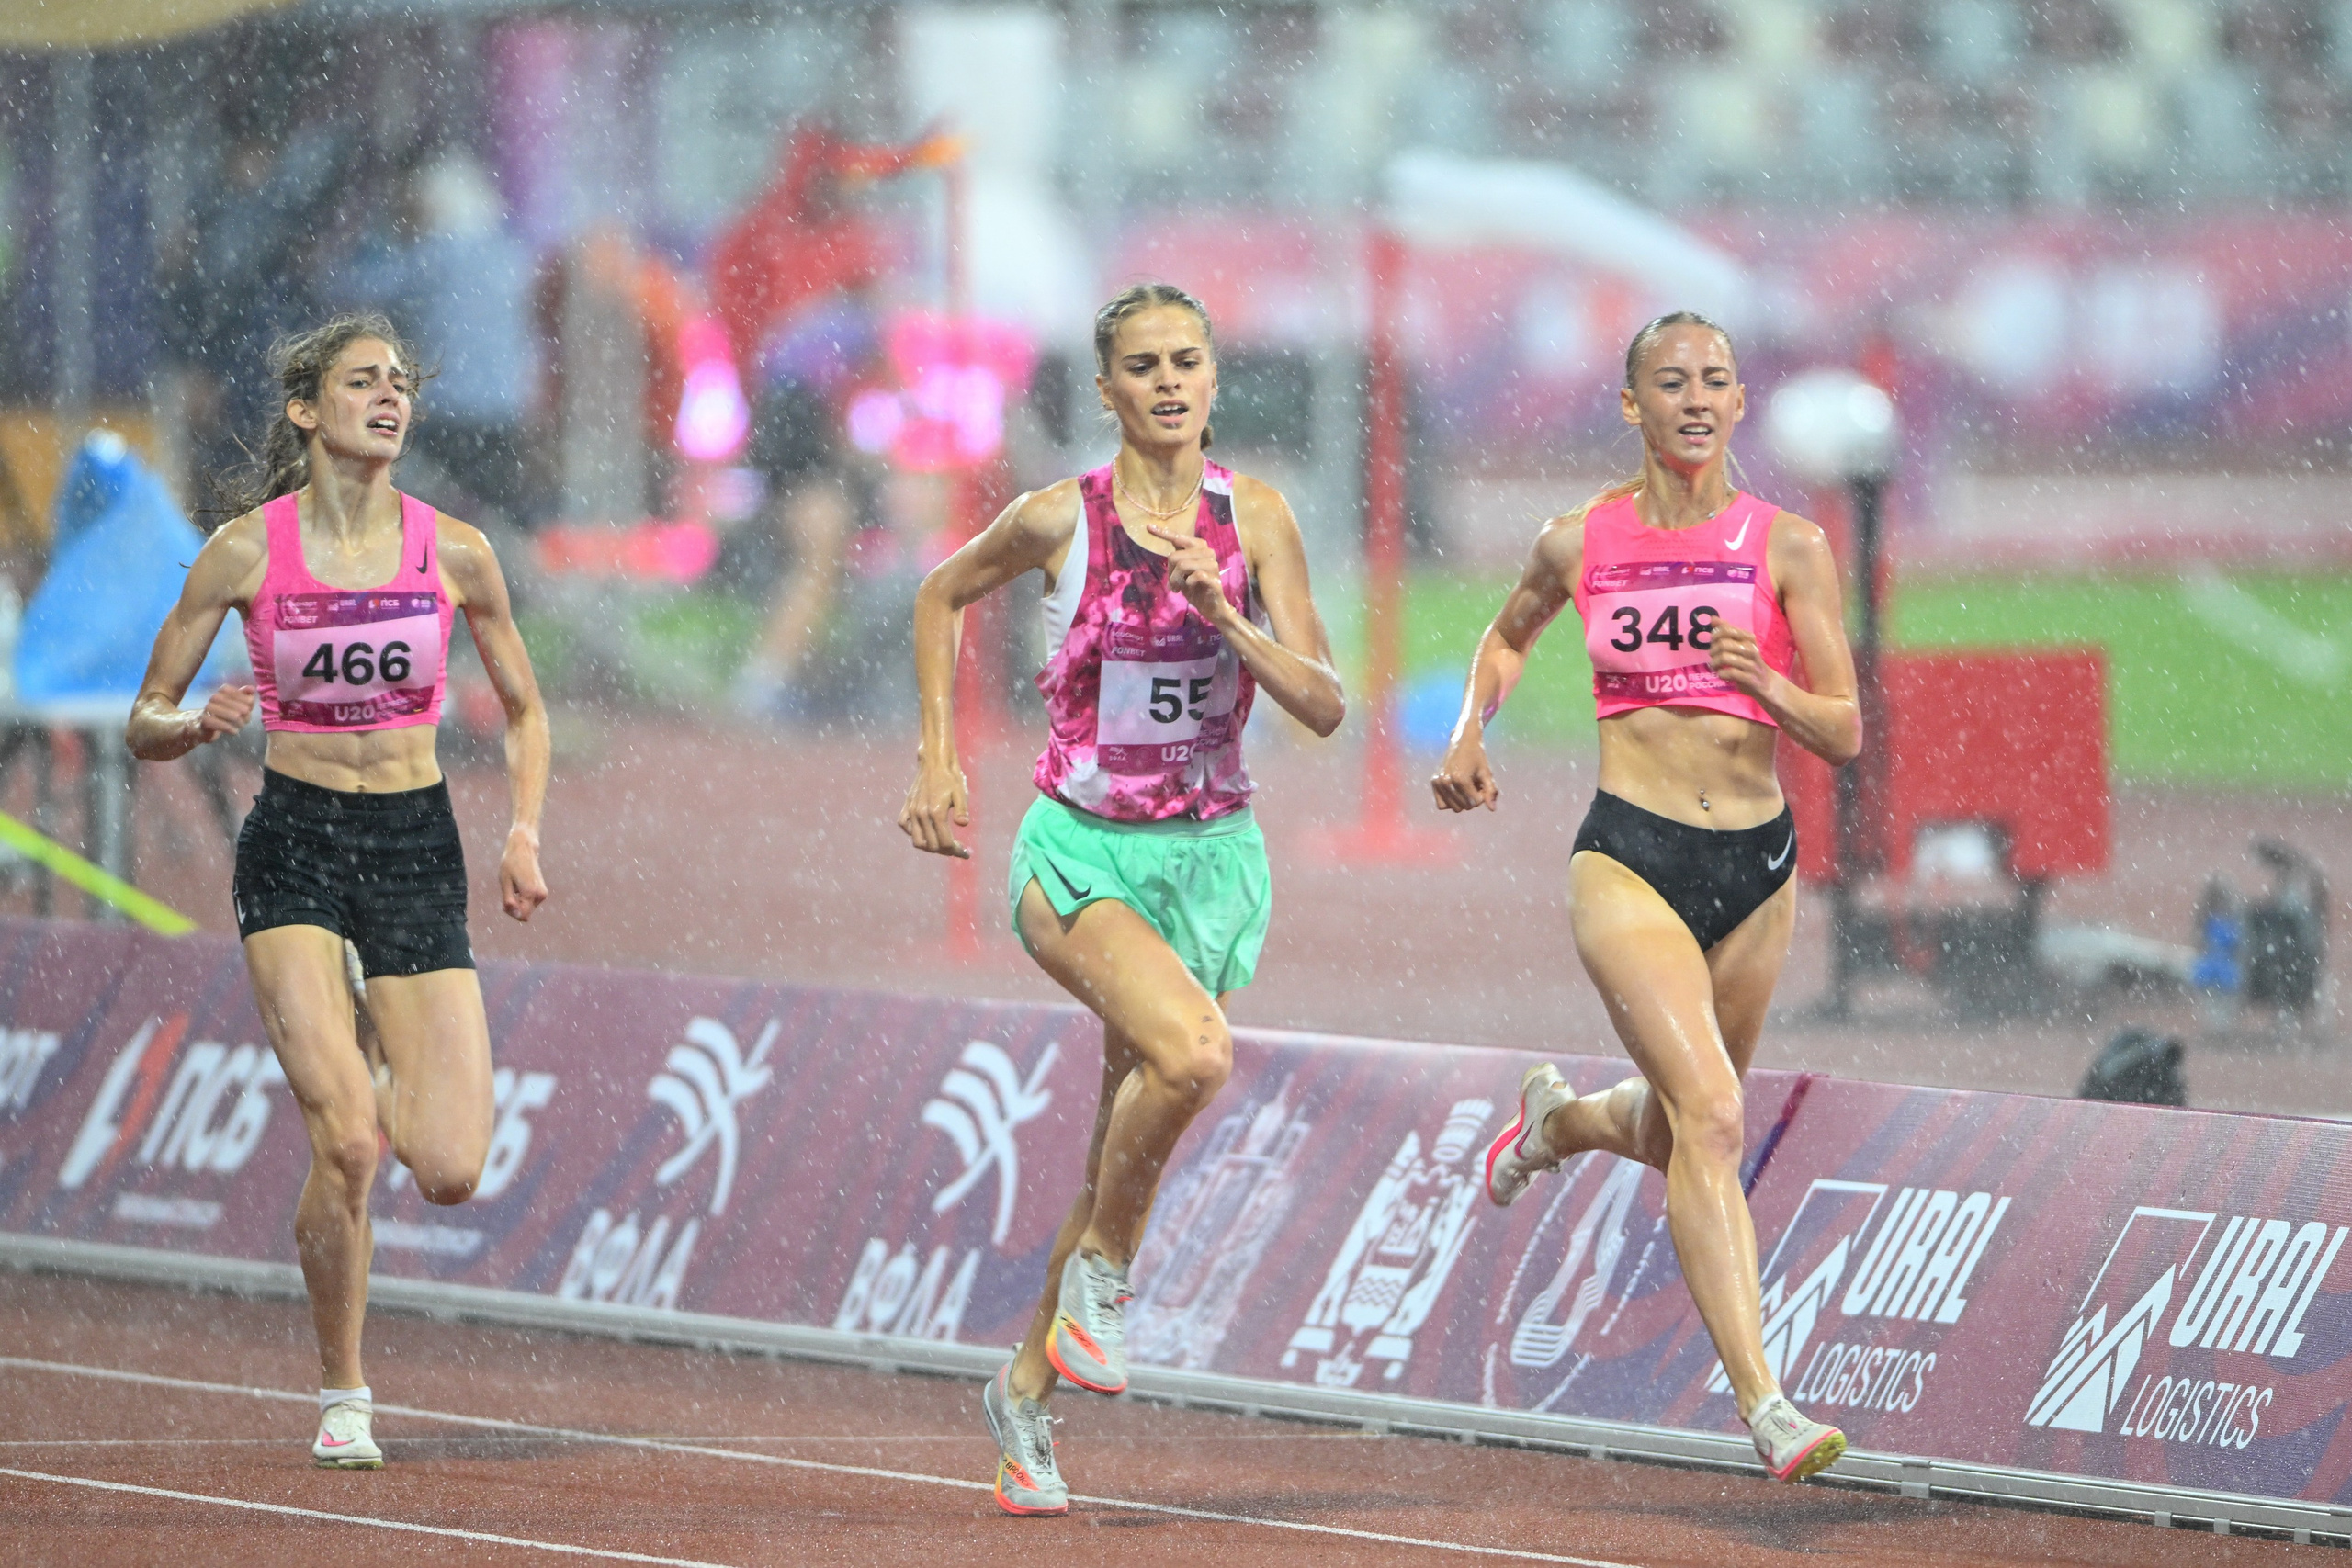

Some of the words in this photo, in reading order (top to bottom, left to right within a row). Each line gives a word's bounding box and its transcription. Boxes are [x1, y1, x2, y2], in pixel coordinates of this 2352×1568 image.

[1111, 646, 1146, 657] FONBET
[1611, 605, 1720, 652] 348
[302, 640, 412, 686] 466
[1645, 673, 1687, 693] U20
[334, 705, 376, 721] U20
[1149, 677, 1213, 724] 55
[1840, 1187, 2012, 1325] URAL
[2168, 1215, 2350, 1359] URAL
[1792, 1341, 1938, 1414] LOGISTICS
[2119, 1374, 2273, 1450] LOGISTICS
